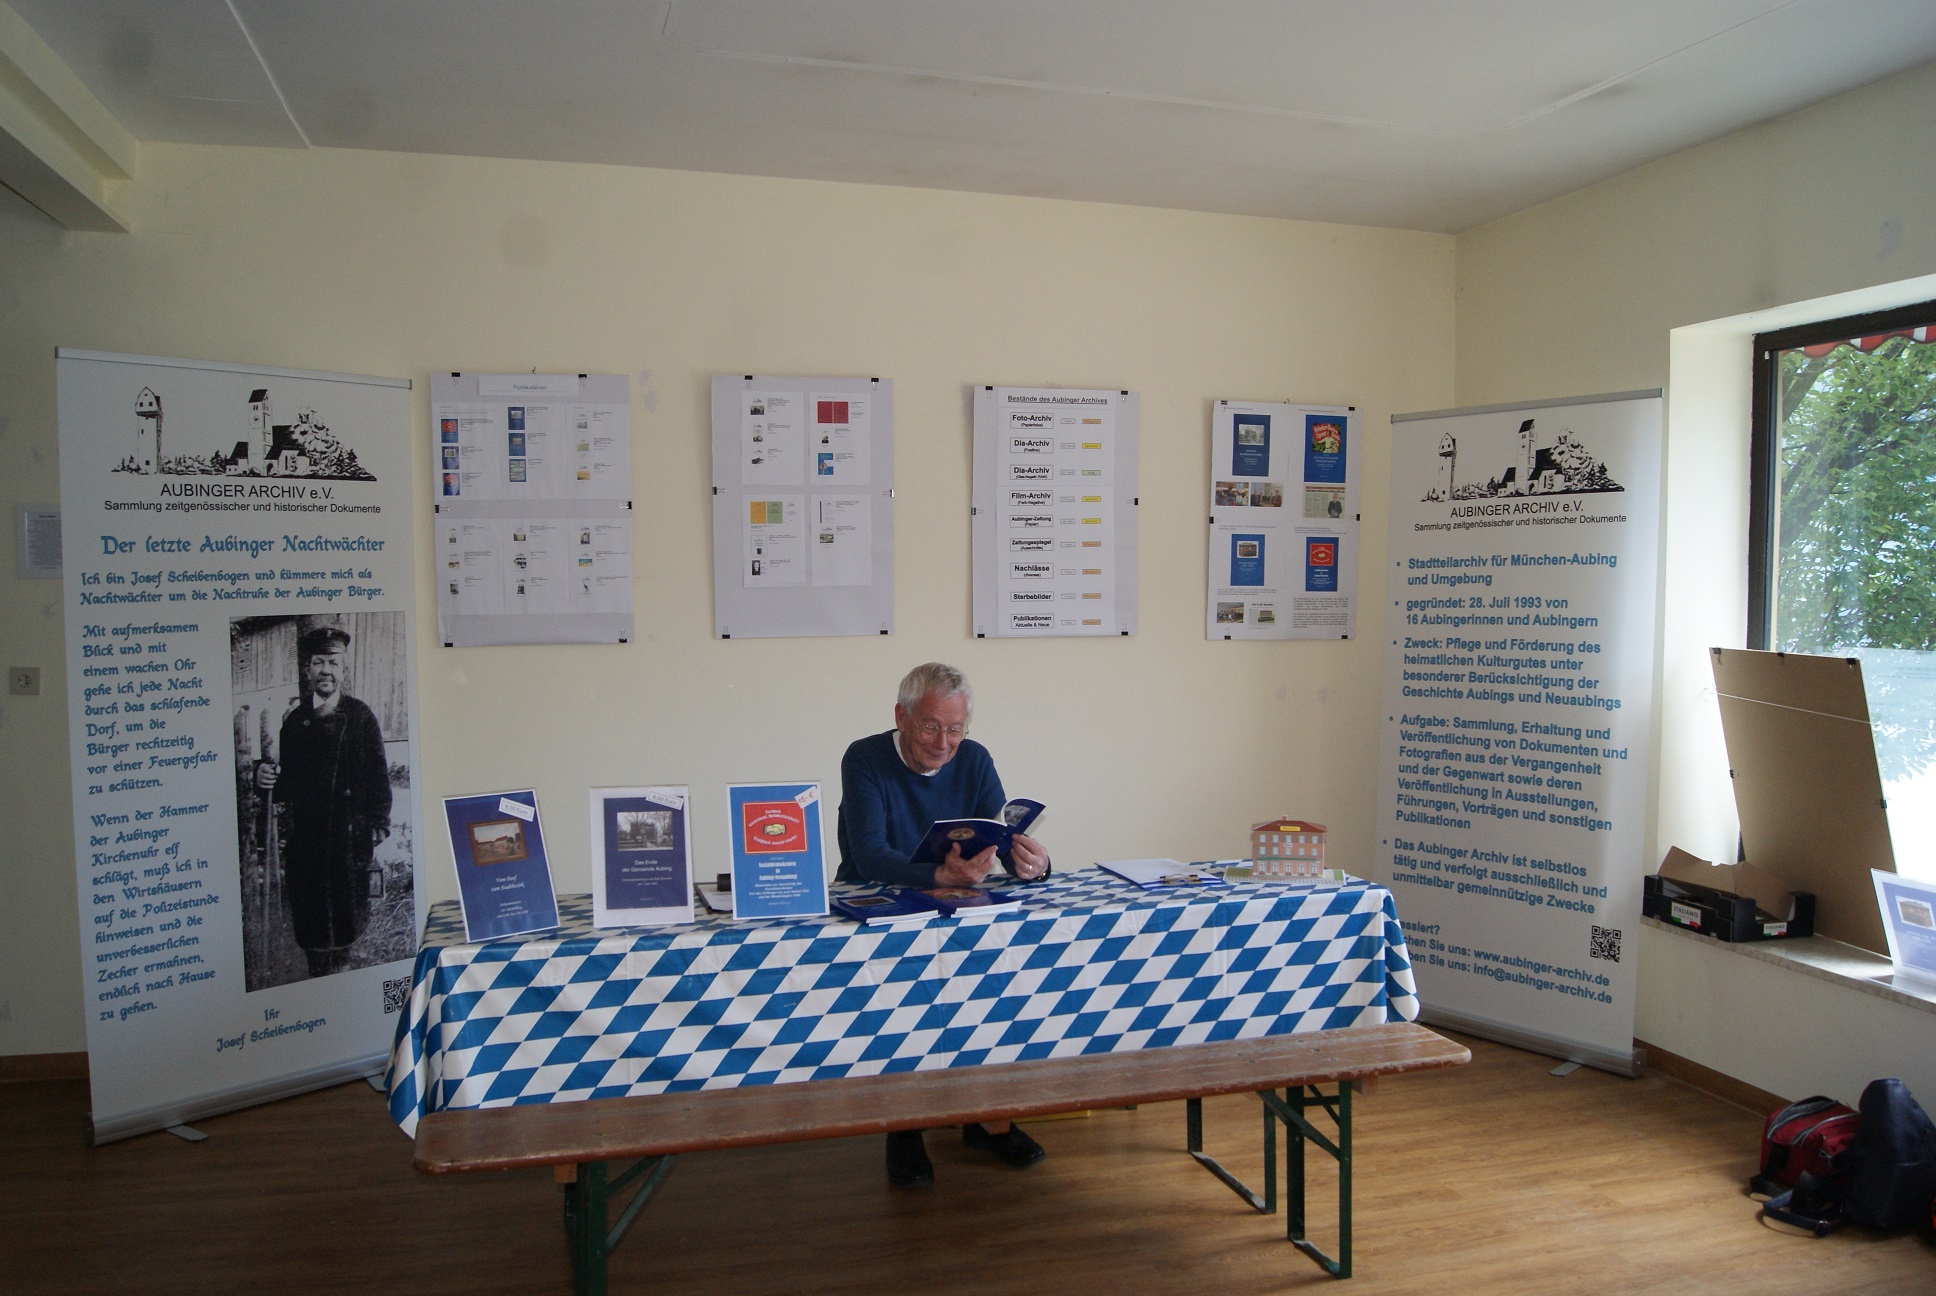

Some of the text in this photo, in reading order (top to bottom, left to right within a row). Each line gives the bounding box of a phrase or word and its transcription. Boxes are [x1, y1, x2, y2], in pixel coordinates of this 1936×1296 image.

[1008, 395, 1038, 403] Bestände
[1052, 396, 1080, 404] Aubinger
[1081, 397, 1108, 405] Archives
[1012, 414, 1053, 422] Foto-Archiv
[160, 484, 333, 499] AUBINGER ARCHIV e.V.
[105, 500, 381, 513] Sammlung zeitgenössischer und historischer Dokumente
[1450, 501, 1583, 518] AUBINGER ARCHIV e.V.
[1415, 515, 1626, 531] Sammlung zeitgenössischer und historischer Dokumente
[100, 535, 385, 559] Der letzte Aubinger Nachtwächter
[1408, 553, 1617, 569] Stadtteilarchiv für München-Aubing
[81, 568, 372, 588] Ich bin Josef Scheibenbogen und kümmere mich als
[1408, 573, 1492, 587] und Umgebung
[80, 586, 384, 605] Nachtwächter um die Nachtruhe der Aubinger Bürger.
[1407, 597, 1568, 611] gegründet: 28. Juli 1993 von
[82, 622, 198, 641] Mit aufmerksamem
[82, 642, 166, 657] Blick und mit
[1404, 637, 1601, 655] Zweck: Pflege und Förderung des
[84, 677, 202, 702] gehe ich jede Nacht
[1403, 686, 1621, 711] Geschichte Aubings und Neuaubings
[1401, 714, 1610, 740] Aufgabe: Sammlung, Erhaltung und
[86, 735, 194, 758] Bürger rechtzeitig
[1400, 730, 1627, 759] Veröffentlichung von Dokumenten und
[1398, 778, 1597, 812] Veröffentlichung in Ausstellungen,
[90, 804, 209, 827] Wenn der Hammer
[1396, 810, 1470, 829] Publikationen
[1397, 794, 1612, 831] Führungen, Vorträgen und sonstigen
[90, 828, 169, 847] der Aubinger
[1395, 838, 1586, 877] Das Aubinger Archiv ist selbstlos
[1393, 872, 1595, 914] unmittelbar gemeinnützige Zwecke
[1673, 906, 1699, 919] ITALIAMO
[1400, 921, 1440, 935] essiert?
[96, 935, 199, 963] unverbesserlichen
[98, 955, 204, 982] Zecher ermahnen,
[1429, 939, 1445, 951] Sie
[1448, 945, 1471, 956] uns:
[1474, 950, 1610, 986] www.aubinger-archiv.de
[1429, 954, 1445, 966] Sie
[1448, 960, 1471, 972] uns:
[1474, 963, 1612, 1004] info@aubinger-archiv.de
[264, 1009, 280, 1021] Ihr
[217, 1018, 326, 1052] Josef Scheibenbogen
